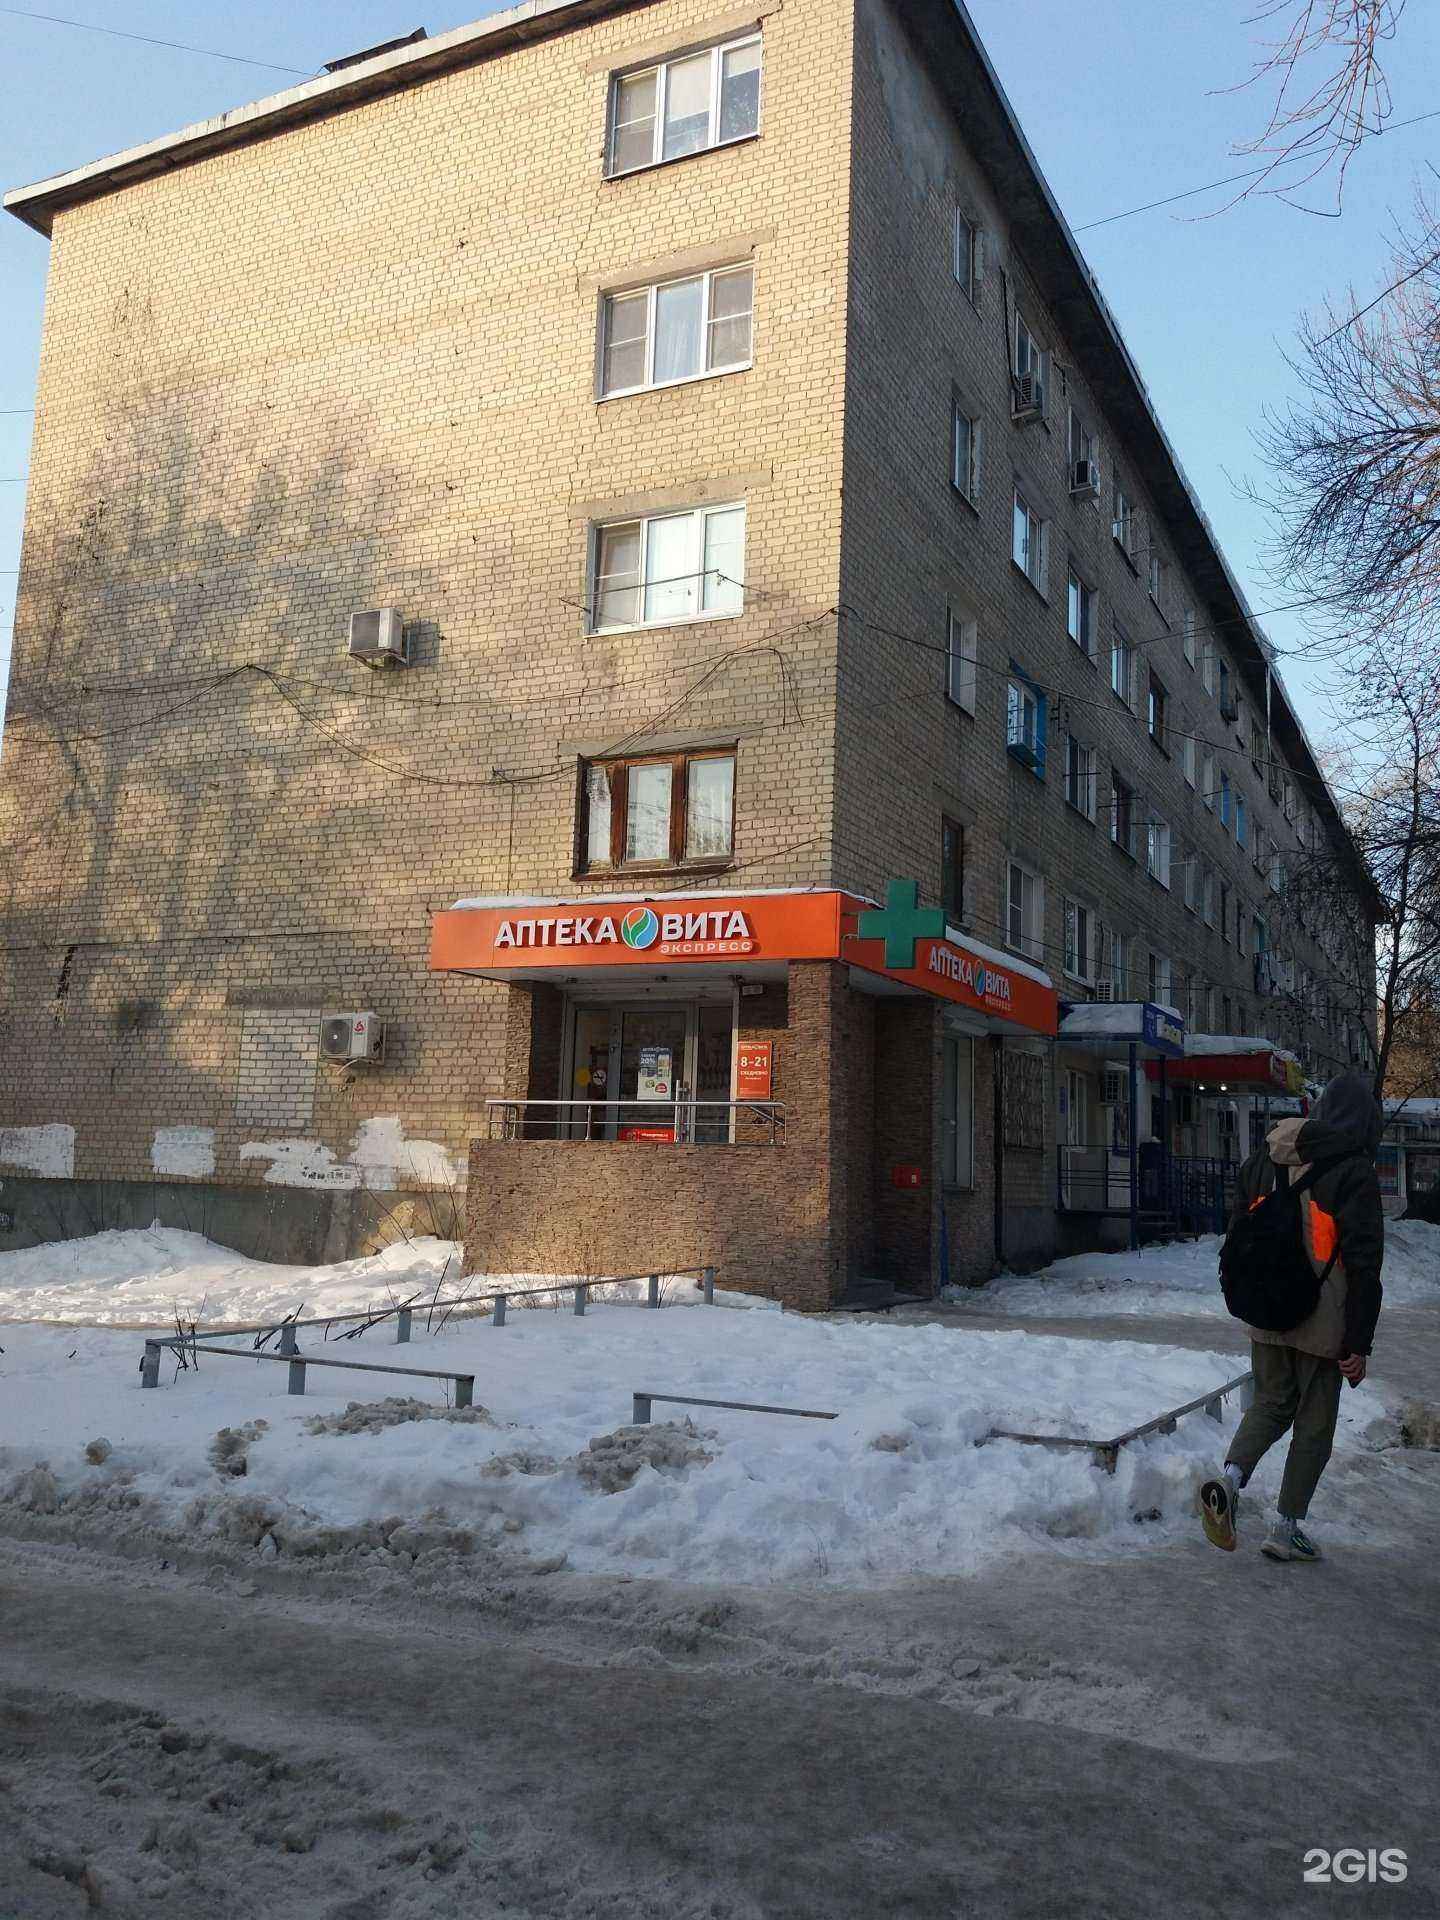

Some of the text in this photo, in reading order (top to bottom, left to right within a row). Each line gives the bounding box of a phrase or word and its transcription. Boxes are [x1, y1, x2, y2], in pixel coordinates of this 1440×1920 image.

[494, 910, 750, 946] АПТЕКА ВИТА
[660, 941, 752, 954] ЭКСПРЕСС
[928, 945, 1011, 1001] АПТЕКА ВИТА
[740, 1056, 768, 1067] 8-21
